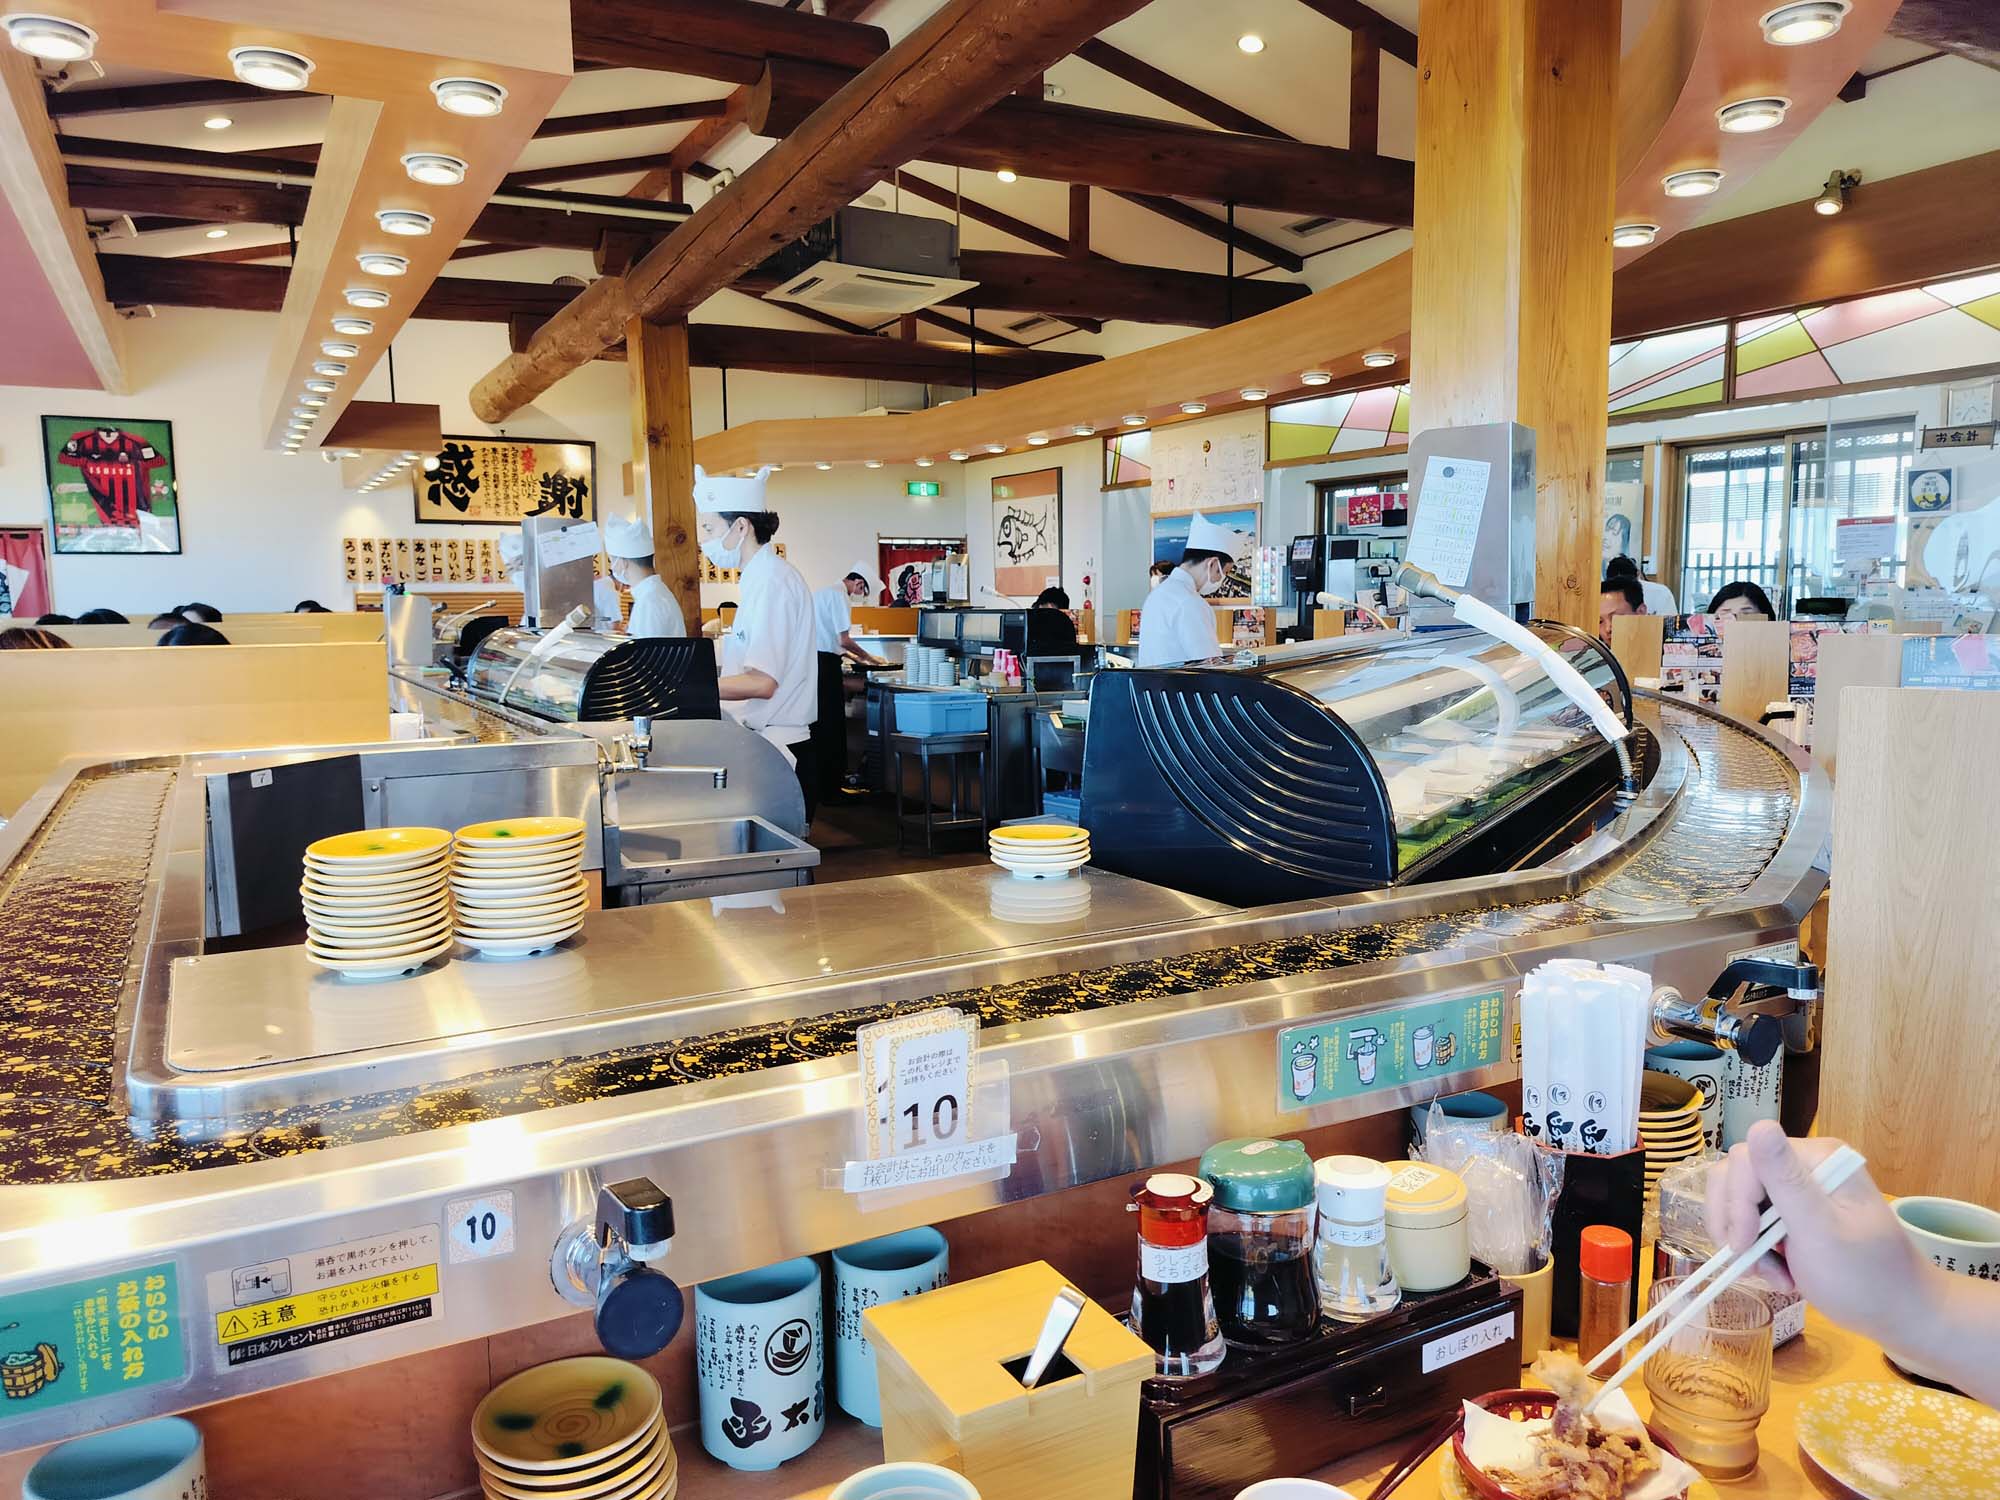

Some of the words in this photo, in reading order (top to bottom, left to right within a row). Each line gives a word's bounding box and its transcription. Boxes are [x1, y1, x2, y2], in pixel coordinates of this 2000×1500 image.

[1936, 430, 1979, 443] お会計
[430, 541, 443, 575] 中トロ
[256, 773, 266, 784] 7
[903, 1094, 959, 1150] 10
[466, 1212, 496, 1243] 10
[144, 1274, 169, 1340] おいしい
[252, 1304, 297, 1329] 注意
[117, 1280, 144, 1380] お茶の入れ方
[1435, 1324, 1502, 1361] おしぼり入れ
